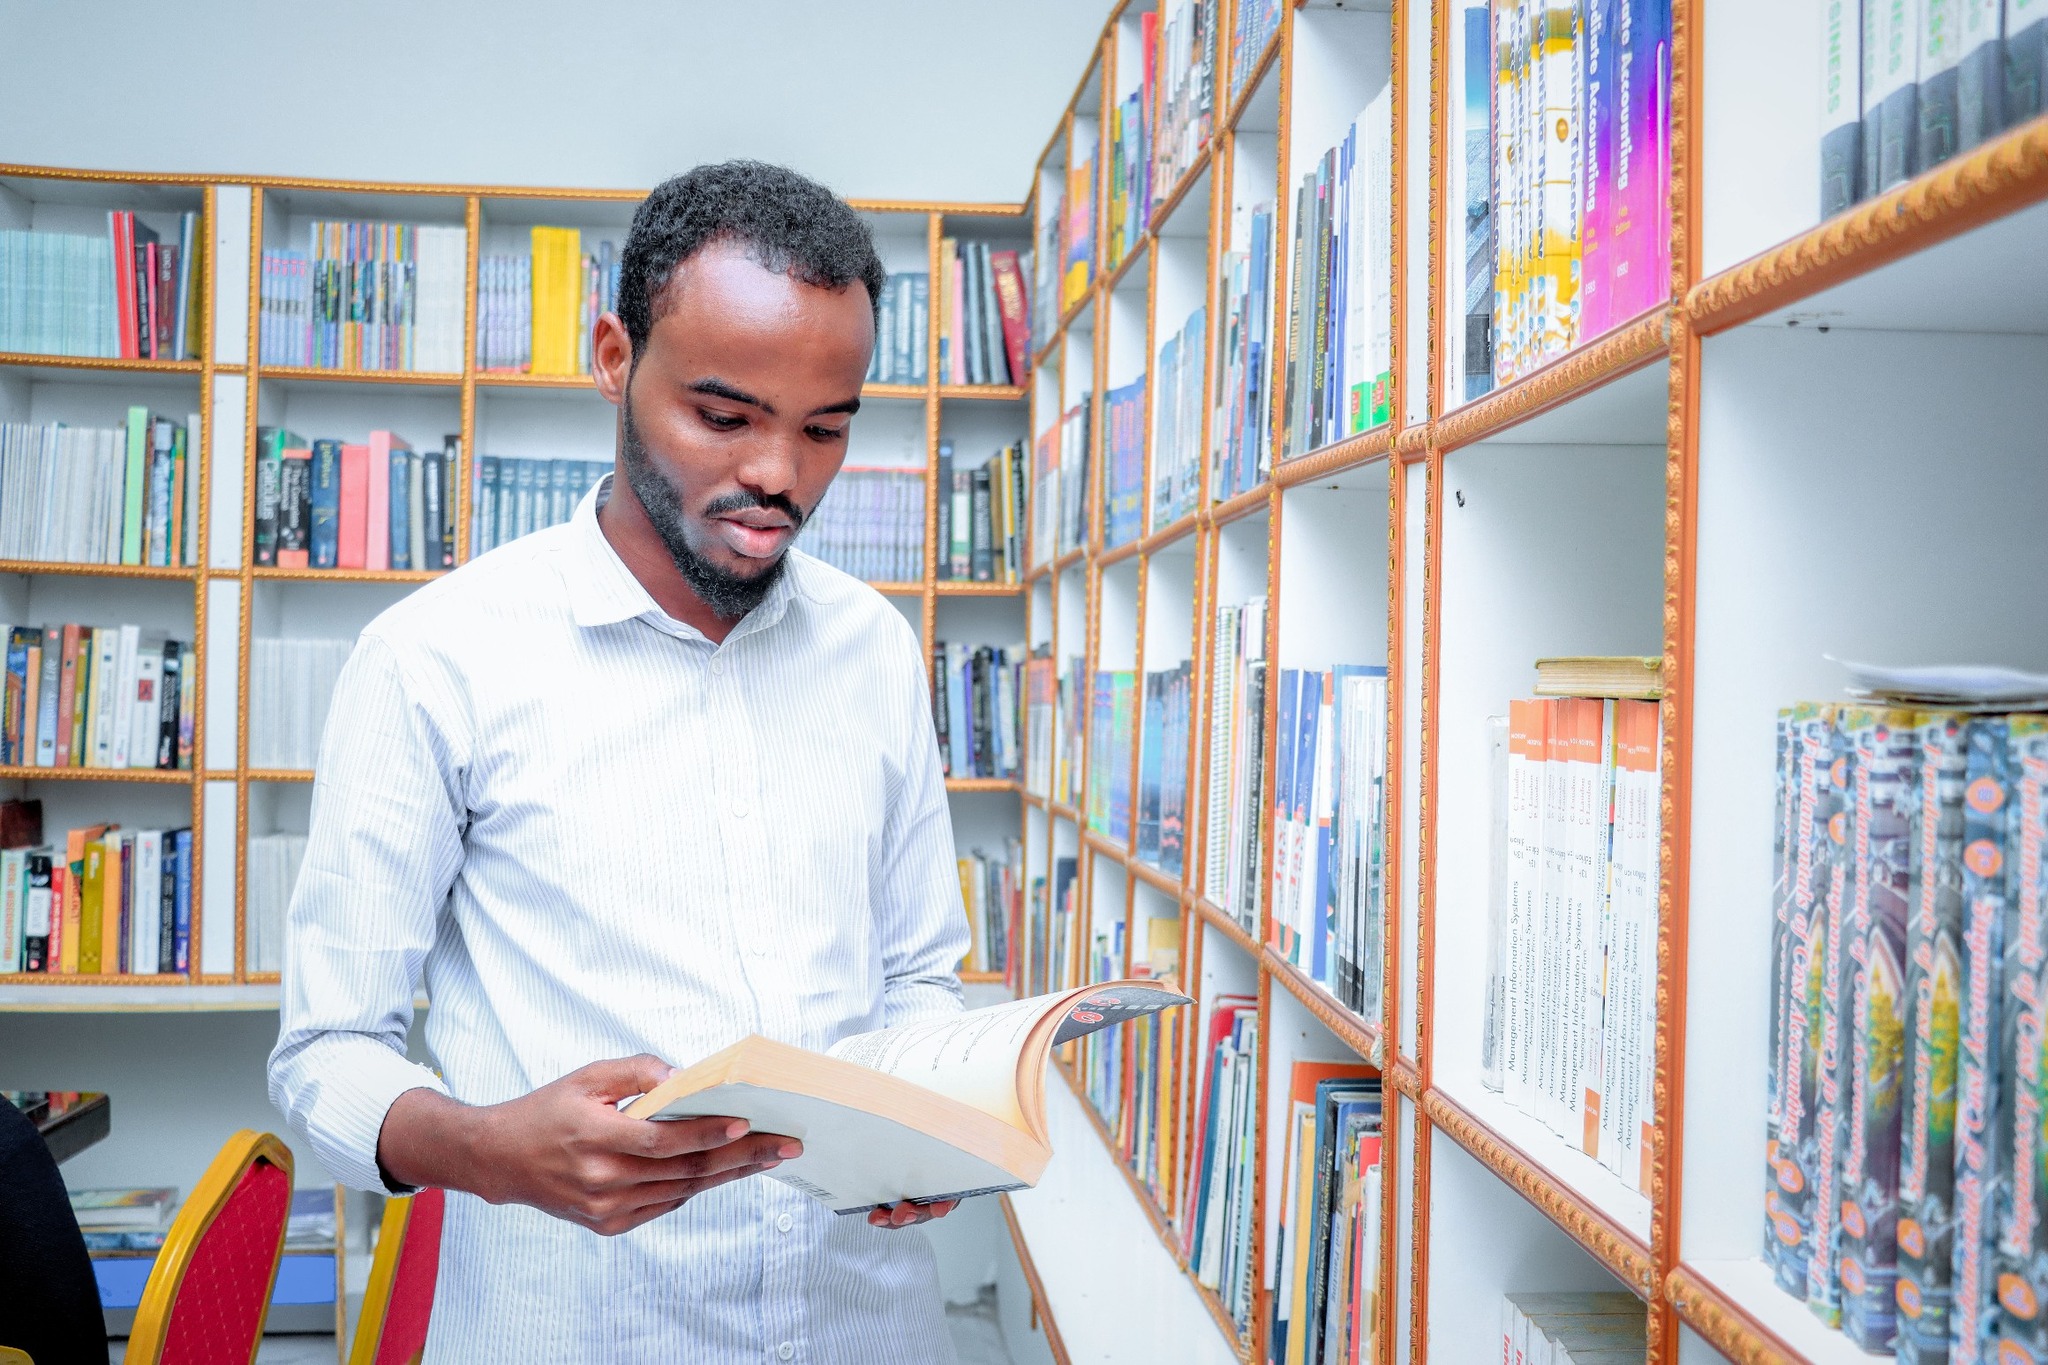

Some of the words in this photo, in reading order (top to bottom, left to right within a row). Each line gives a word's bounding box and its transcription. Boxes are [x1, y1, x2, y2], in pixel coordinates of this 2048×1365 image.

[1586, 81, 1600, 213] Accounting
[1618, 51, 1633, 190] Accounting
[262, 459, 281, 521] Calculus
[289, 487, 301, 529] Complete
[290, 469, 302, 486] The
[44, 657, 57, 682] Life
[1248, 796, 1259, 869] BEHAVIOR
[1795, 736, 1819, 909] Fundamentals
[1852, 747, 1873, 931] Fundamentals
[1919, 745, 1941, 933] Fundamentals
[2017, 759, 2047, 969] Fundamentals
[1510, 881, 1519, 925] Systems
[1574, 902, 1582, 951] Systems
[1609, 913, 1617, 962] Systems
[1790, 915, 1812, 943] of
[1820, 864, 1845, 1005] Accounting
[1509, 928, 1518, 993] Information
[1562, 949, 1571, 1018] Information
[1630, 922, 1638, 975] Systems
[1790, 947, 1812, 1003] Cost
[1849, 940, 1870, 966] of
[1914, 943, 1935, 967] of
[1963, 899, 1992, 1064] Accounting
[1571, 955, 1580, 1026] Information
[1606, 967, 1615, 1041] Information
[1620, 976, 1628, 1052] Information
[1628, 979, 1636, 1057] Information
[1851, 971, 1869, 1028] Cost
[1915, 977, 1934, 1037] Cost
[2010, 973, 2040, 1008] of
[1508, 996, 1518, 1072] Management
[1559, 1022, 1568, 1103] Management
[1818, 1009, 1839, 1072] Cost
[2014, 1013, 2041, 1083] Cost
[1569, 1030, 1578, 1112] Management
[1602, 1045, 1611, 1130] Management
[1617, 1056, 1625, 1144] Management
[1625, 1061, 1634, 1150] Management
[1783, 1003, 1809, 1142] Accounting
[1960, 1065, 1985, 1132] Cost
[1322, 1149, 1334, 1226] Managerial
[1962, 1137, 1984, 1170] of
[1317, 1231, 1330, 1307] Accounting
[1334, 1222, 1343, 1247] and
